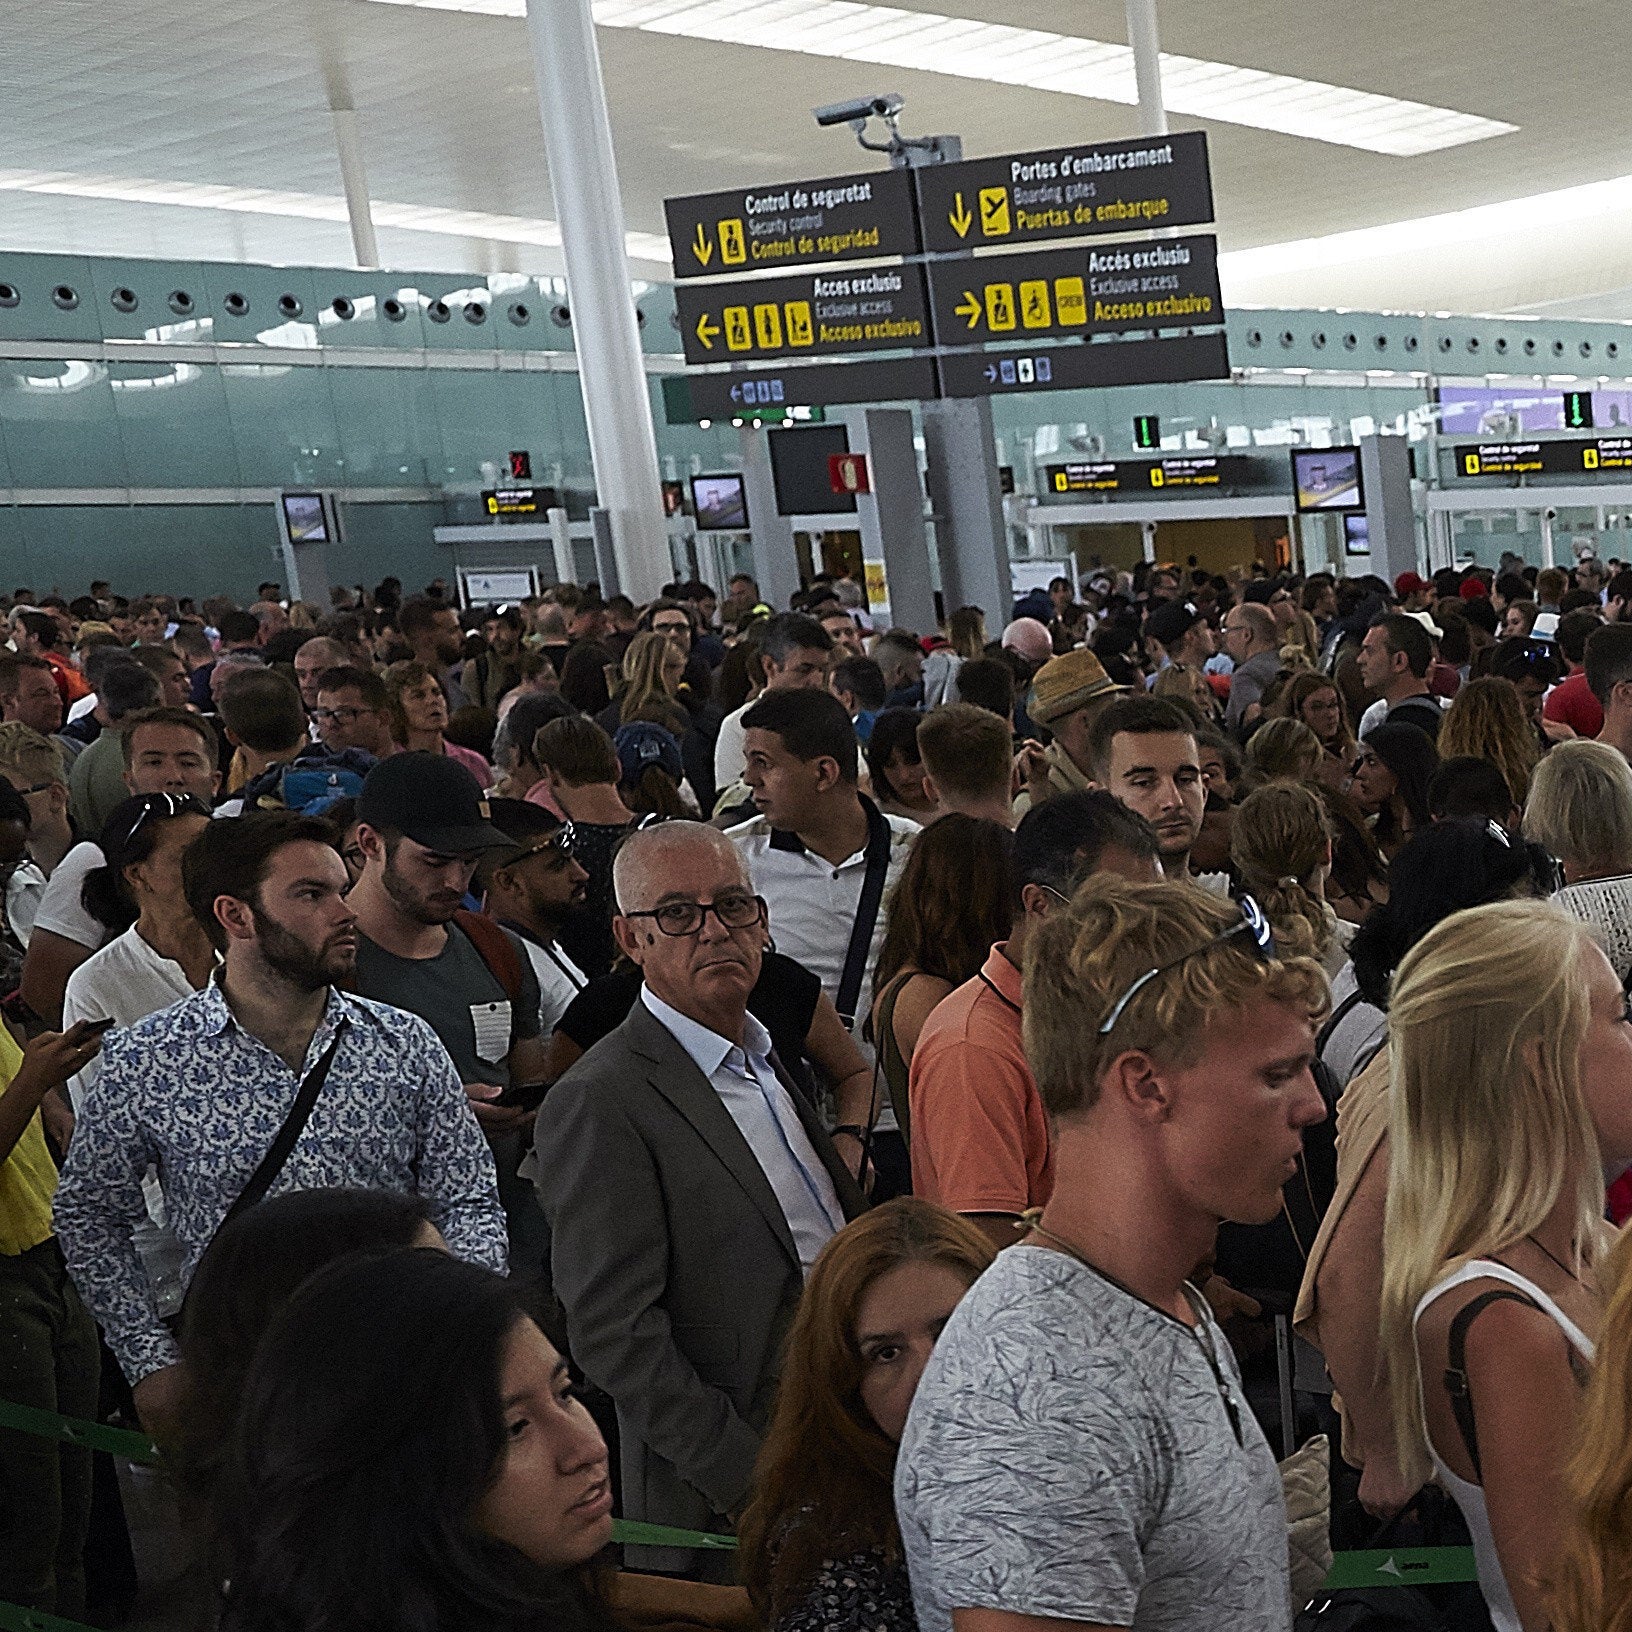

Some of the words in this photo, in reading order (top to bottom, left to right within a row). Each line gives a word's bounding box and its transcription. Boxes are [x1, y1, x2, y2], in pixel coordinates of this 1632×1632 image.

[1011, 161, 1057, 182] Portes
[1060, 144, 1174, 177] d'embarcament
[745, 191, 790, 215] Control
[793, 190, 808, 209] de
[811, 182, 872, 209] seguretat
[1013, 184, 1063, 205] Boarding
[1065, 182, 1097, 203] gates
[749, 218, 787, 236] Security
[789, 212, 823, 231] control
[1016, 209, 1071, 230] Puertas
[1074, 203, 1092, 224] de
[1096, 198, 1169, 221] embarque
[752, 237, 796, 260] Control
[798, 235, 814, 254] de
[817, 226, 879, 254] seguridad
[1133, 244, 1190, 269] exclusiu
[1090, 276, 1139, 296] Exclusive
[1141, 274, 1179, 292] access
[1094, 300, 1144, 321] Acceso
[1146, 292, 1212, 317] exclusivo
